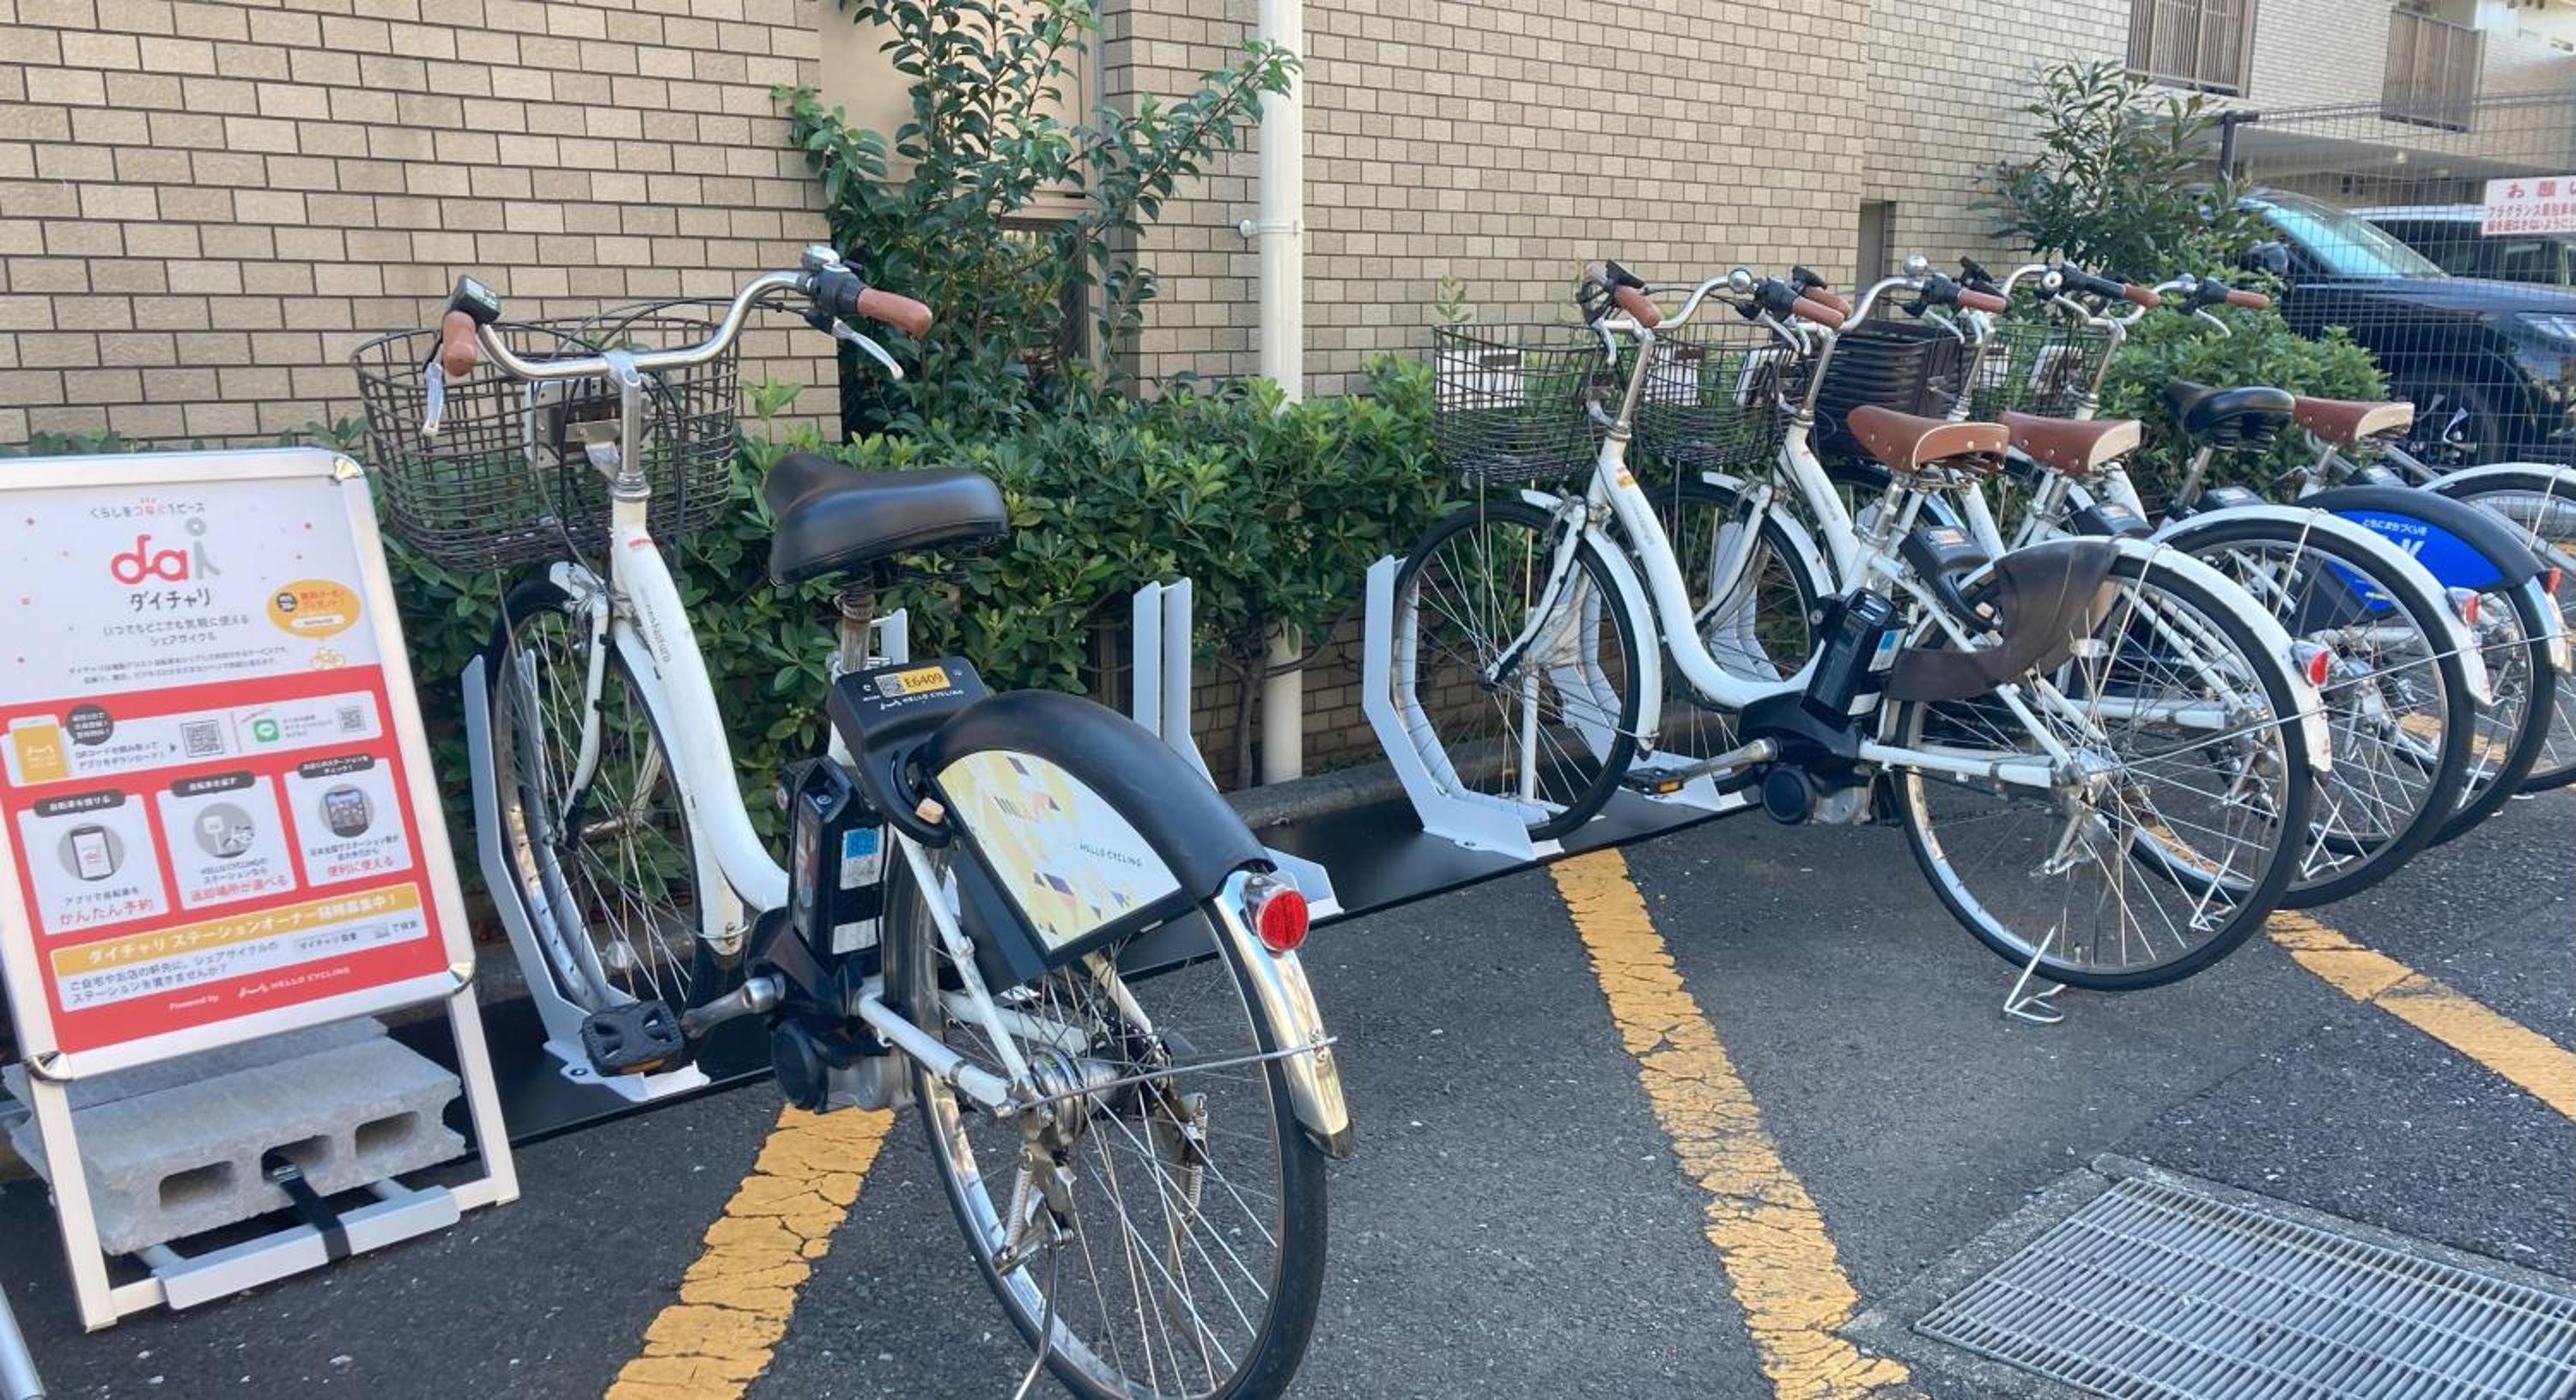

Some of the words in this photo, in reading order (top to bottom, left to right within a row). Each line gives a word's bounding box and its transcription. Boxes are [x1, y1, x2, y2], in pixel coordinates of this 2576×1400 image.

[130, 588, 210, 612] ダイチャリ
[904, 672, 943, 688] E6409
[1079, 843, 1105, 859] HELLO
[1107, 850, 1143, 868] CYCLING
[60, 898, 154, 925] かんたん予約
[270, 977, 304, 989] HELLO
[307, 966, 351, 982] CYCLING
